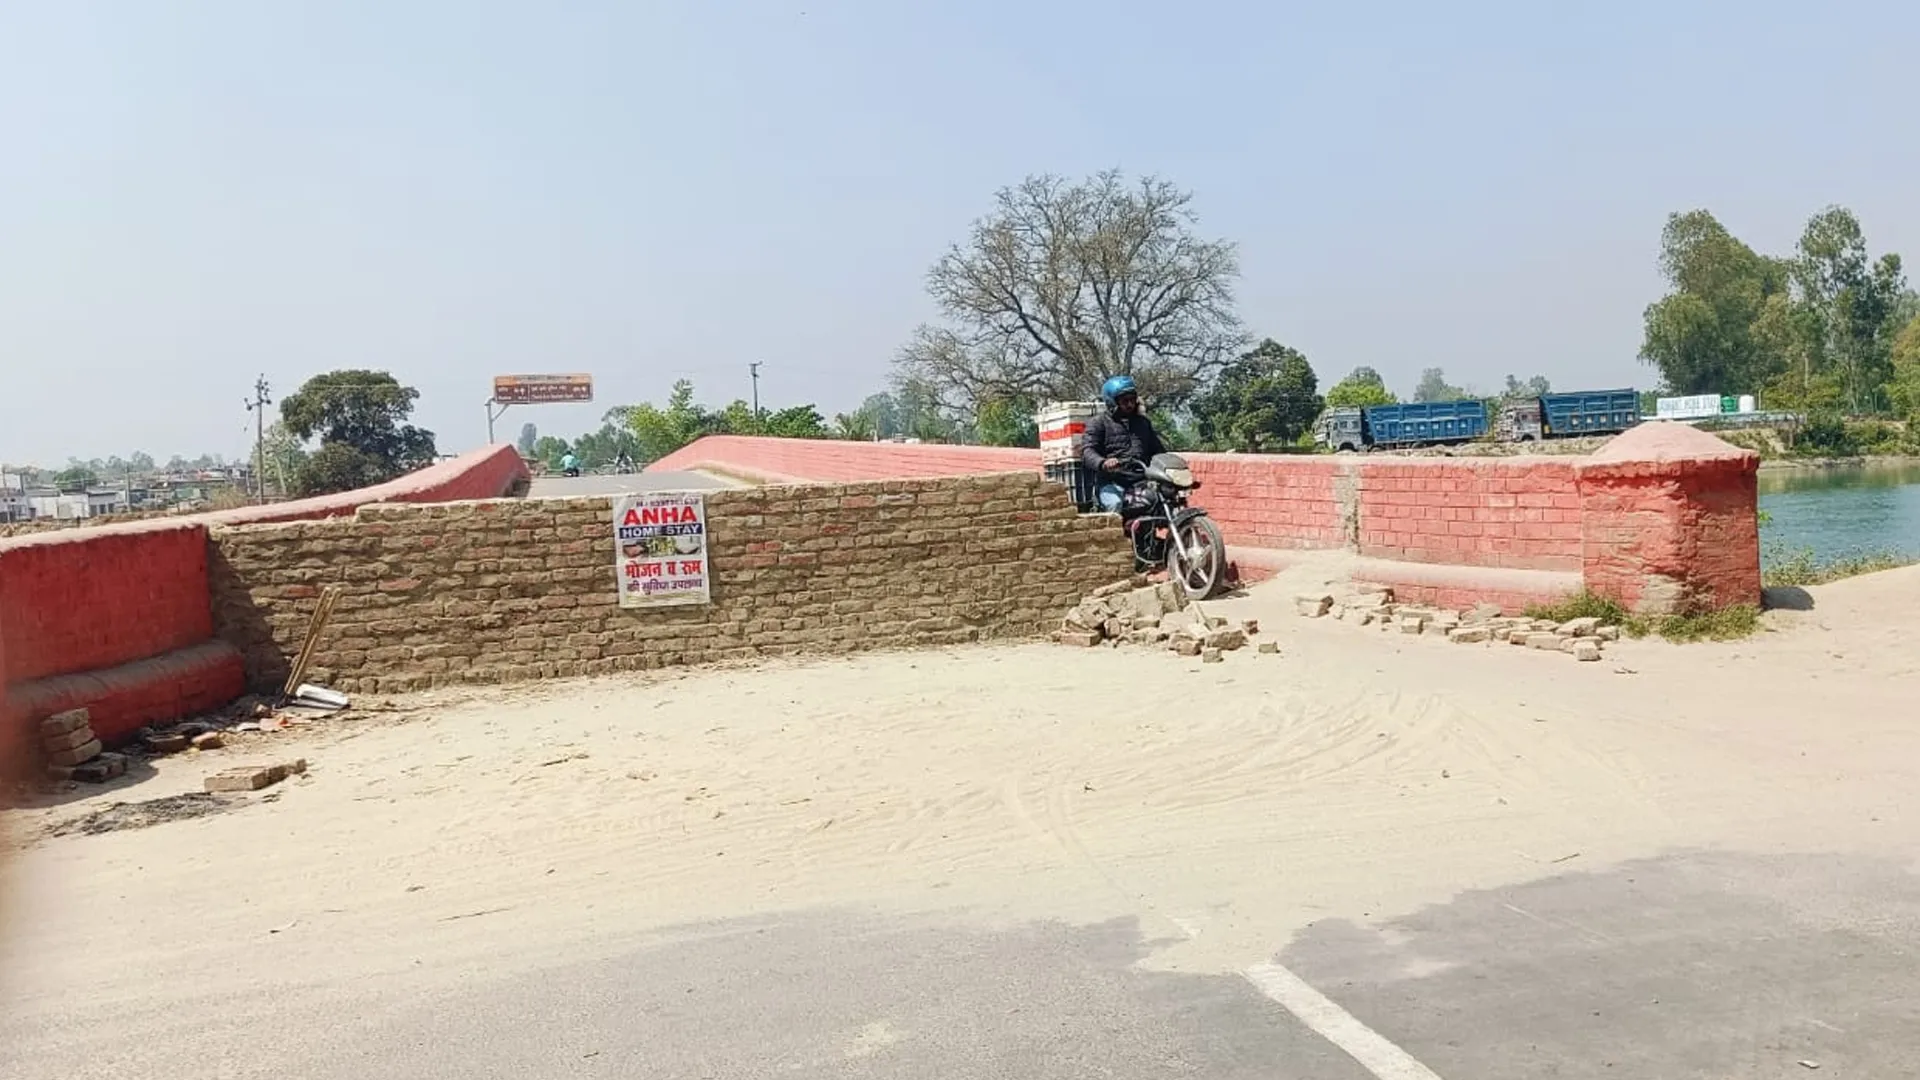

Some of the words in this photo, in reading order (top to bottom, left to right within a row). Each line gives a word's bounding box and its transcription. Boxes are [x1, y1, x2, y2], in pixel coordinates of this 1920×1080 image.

[624, 506, 698, 525] ANHA
[623, 527, 660, 538] HOME
[667, 524, 699, 535] STAY
[666, 561, 677, 575] व
